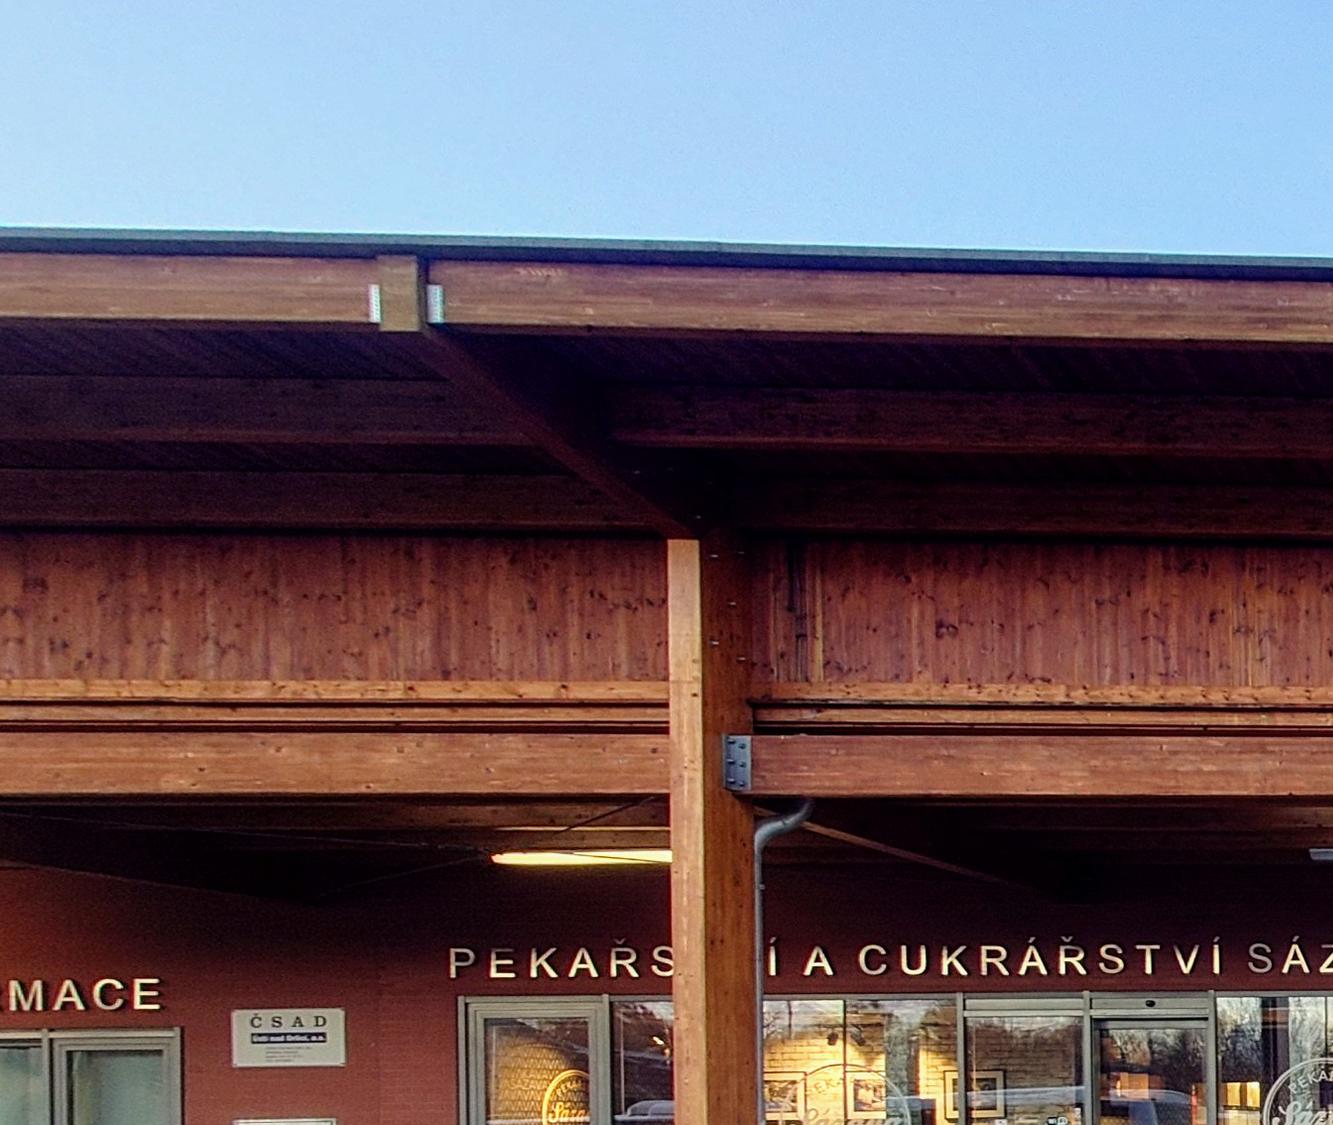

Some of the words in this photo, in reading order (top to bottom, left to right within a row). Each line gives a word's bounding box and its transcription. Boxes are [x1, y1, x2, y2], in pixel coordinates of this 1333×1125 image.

[449, 936, 777, 980] PEKAŘSÍ
[802, 945, 834, 976] A
[858, 935, 1221, 976] CUKRÁŘSTVÍ
[8, 978, 161, 1012] MACE
[250, 1012, 328, 1029] ČSAD
